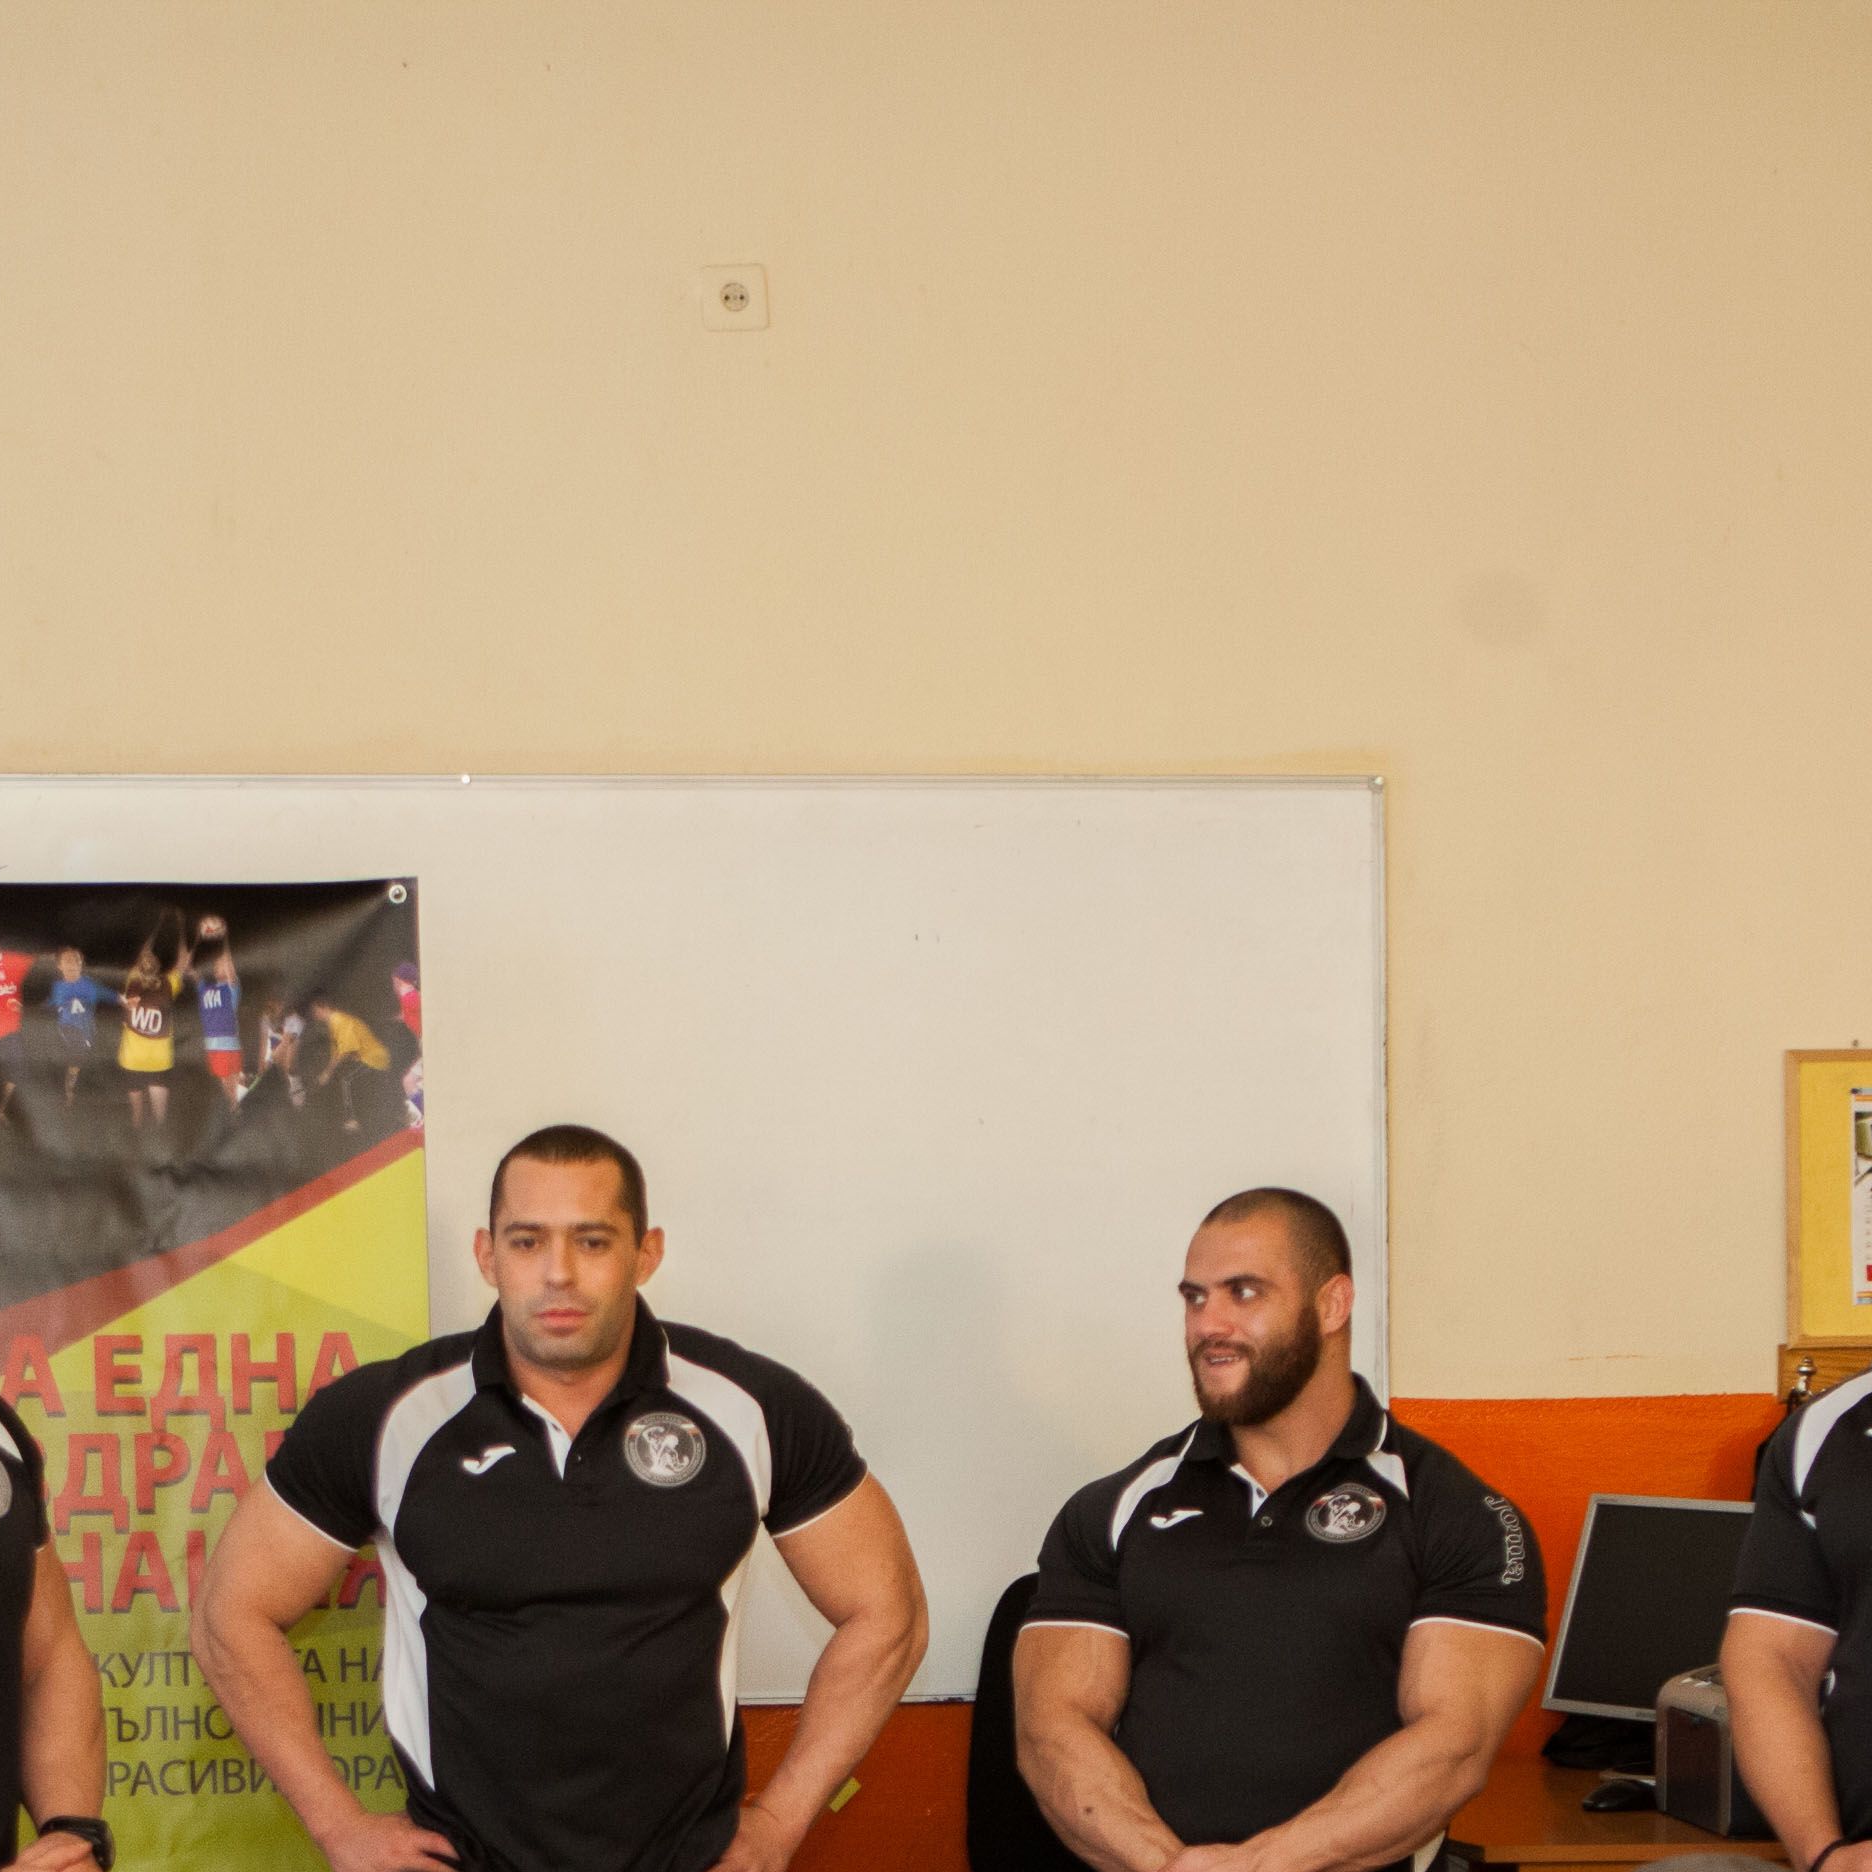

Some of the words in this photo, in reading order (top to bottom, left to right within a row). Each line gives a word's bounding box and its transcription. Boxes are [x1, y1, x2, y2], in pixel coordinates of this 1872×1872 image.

[130, 1005, 163, 1034] WD
[93, 1332, 362, 1431] ЕДНА
[36, 1430, 286, 1536] ДРА
[107, 1757, 276, 1797] РАСИВИ
